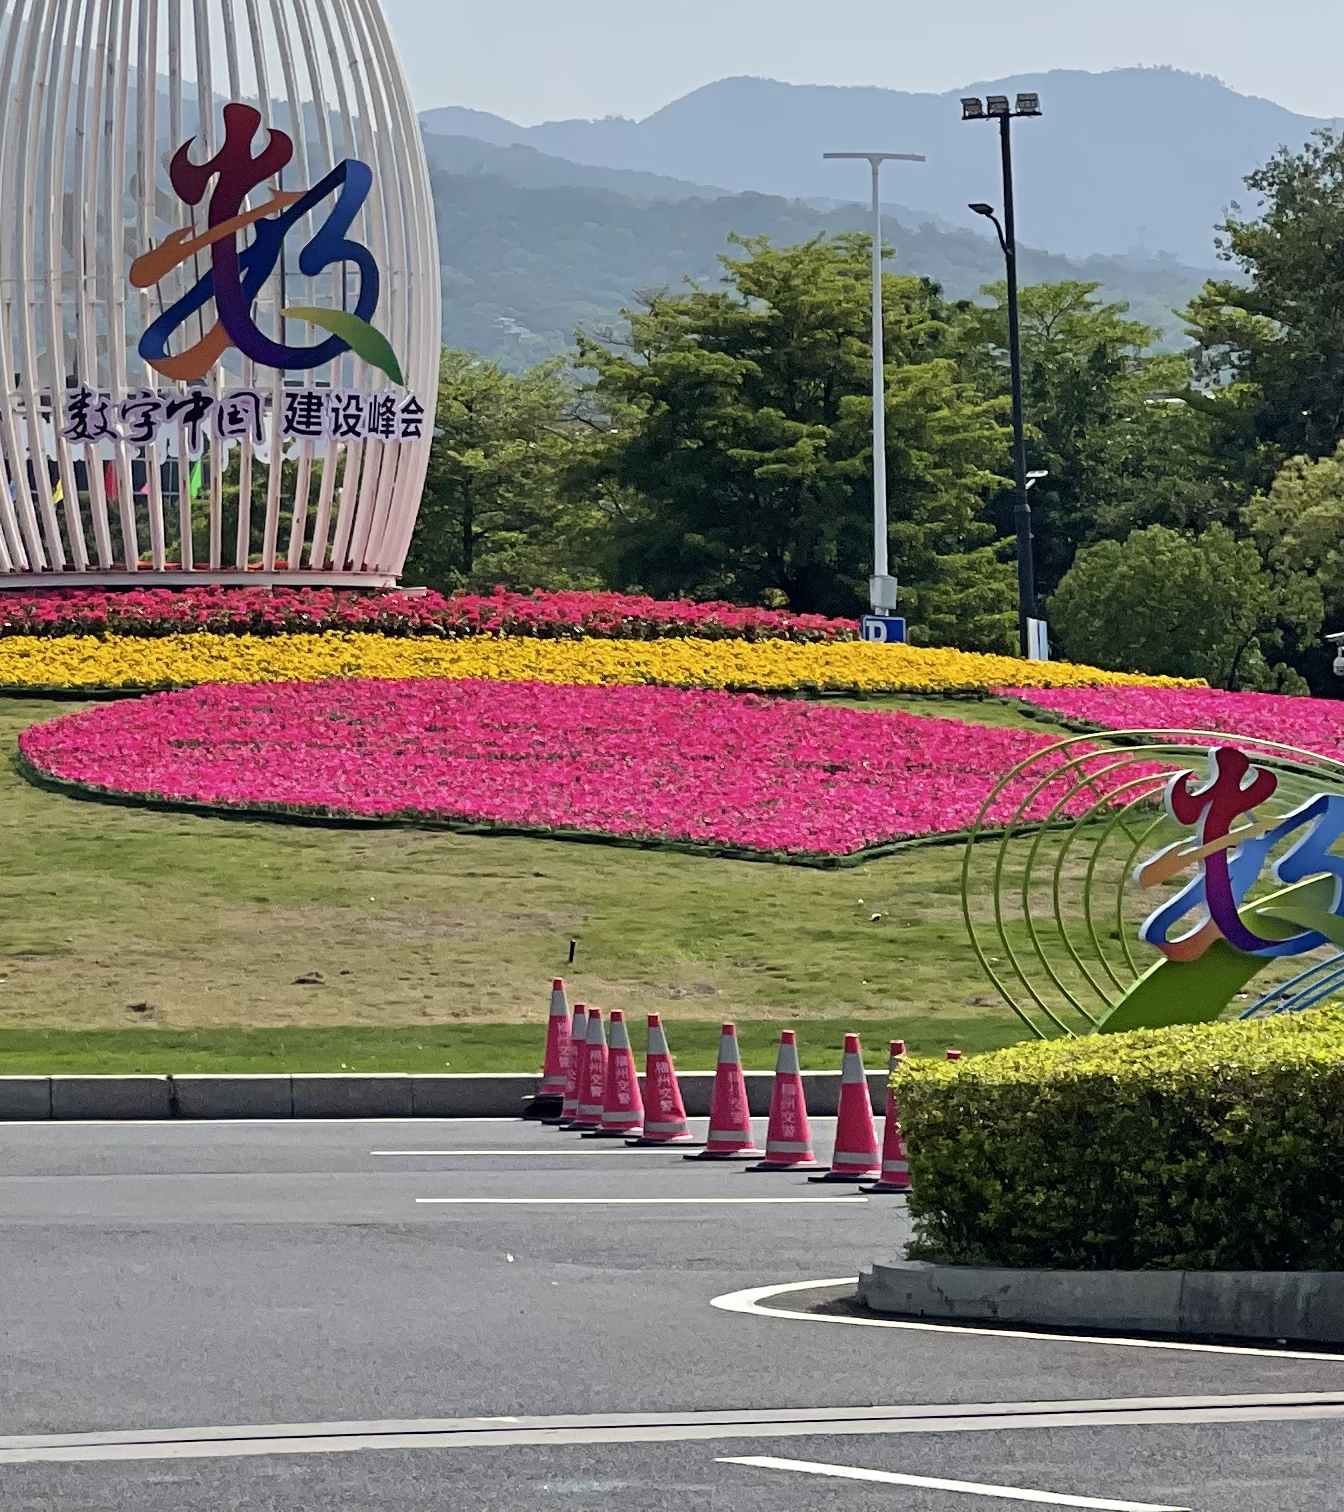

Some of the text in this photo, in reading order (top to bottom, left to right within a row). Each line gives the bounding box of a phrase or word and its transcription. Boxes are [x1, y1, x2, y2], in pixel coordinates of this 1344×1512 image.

[63, 388, 424, 449] 数字中国建设峰会
